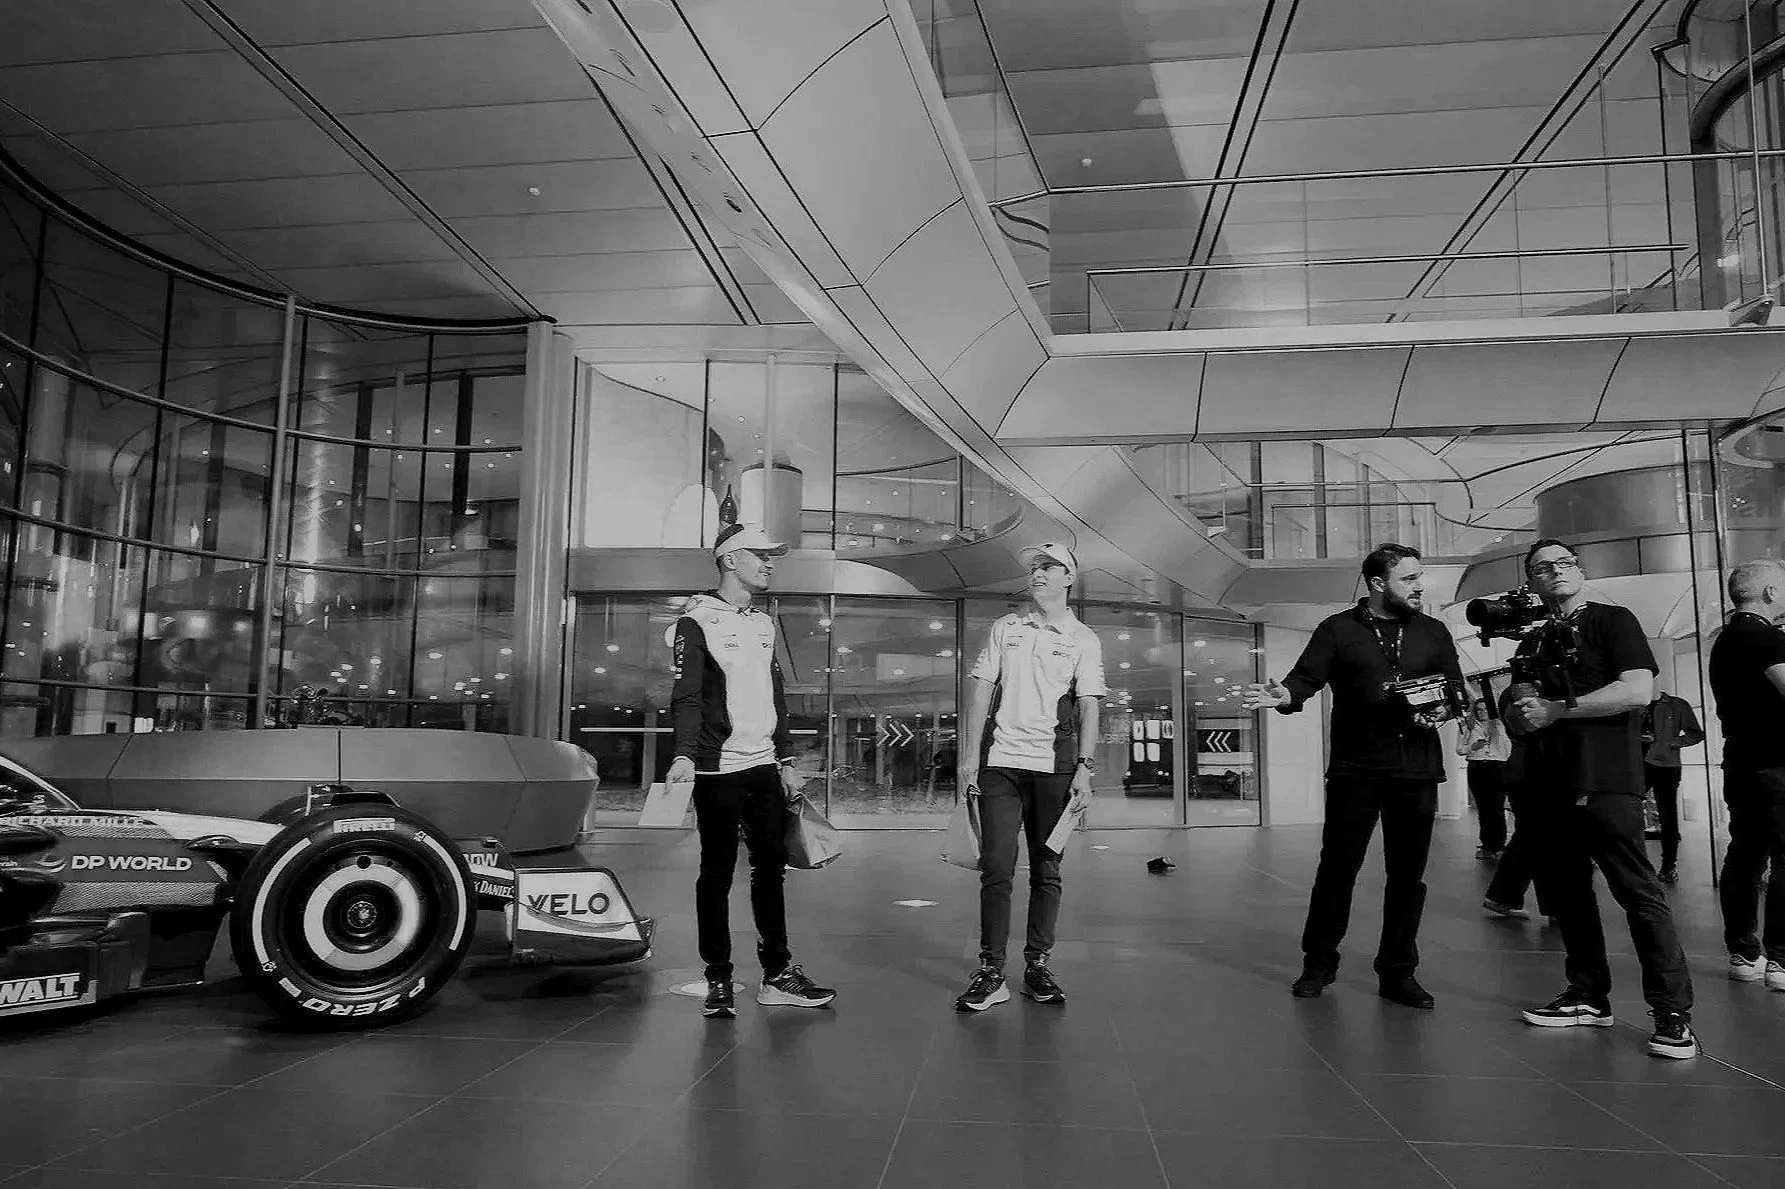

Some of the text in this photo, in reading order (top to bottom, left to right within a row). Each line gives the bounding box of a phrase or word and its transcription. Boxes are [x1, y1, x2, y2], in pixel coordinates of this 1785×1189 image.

[71, 855, 192, 871] DP WORLD
[527, 892, 610, 916] VELO
[301, 976, 426, 1017] P ZERO
